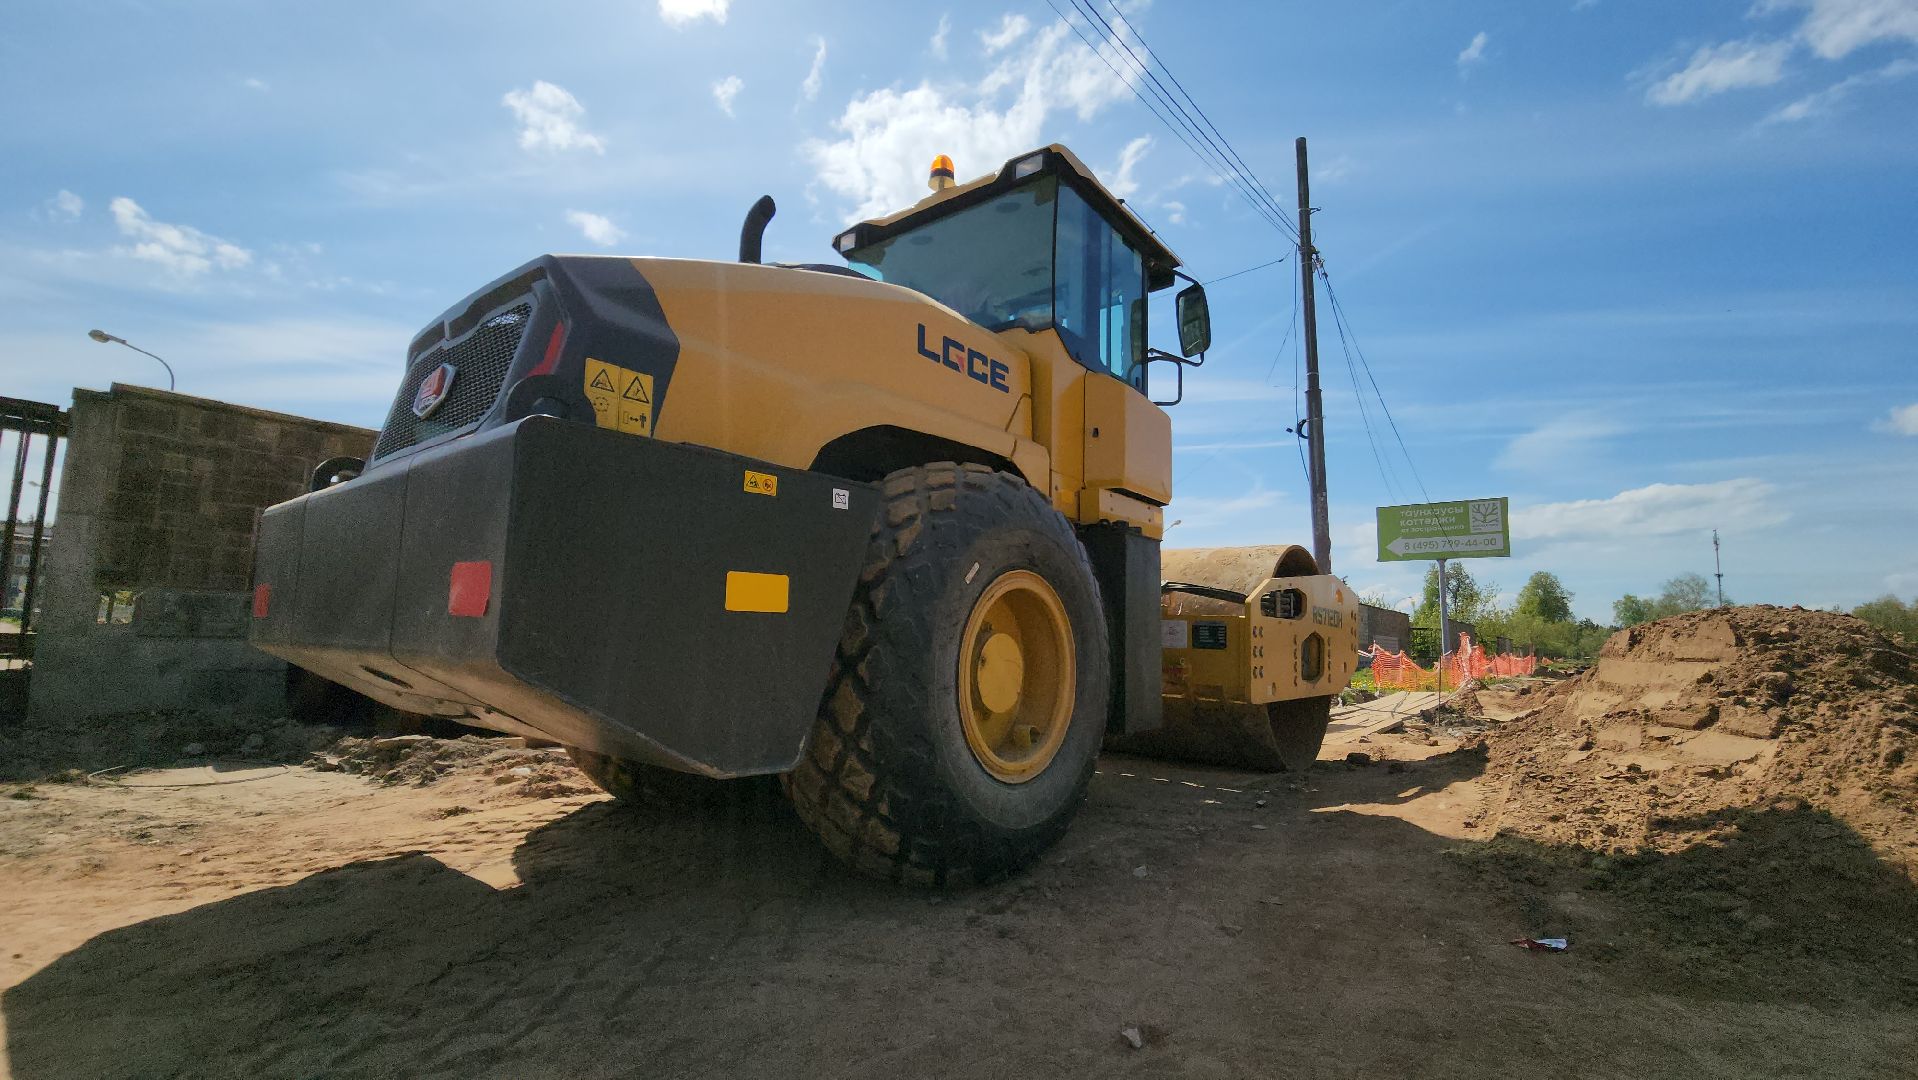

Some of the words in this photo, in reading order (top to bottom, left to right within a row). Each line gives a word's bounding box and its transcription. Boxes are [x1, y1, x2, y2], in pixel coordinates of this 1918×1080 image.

[917, 323, 1009, 394] LGCE
[1404, 542, 1410, 551] 8
[1413, 540, 1439, 550] (495)
